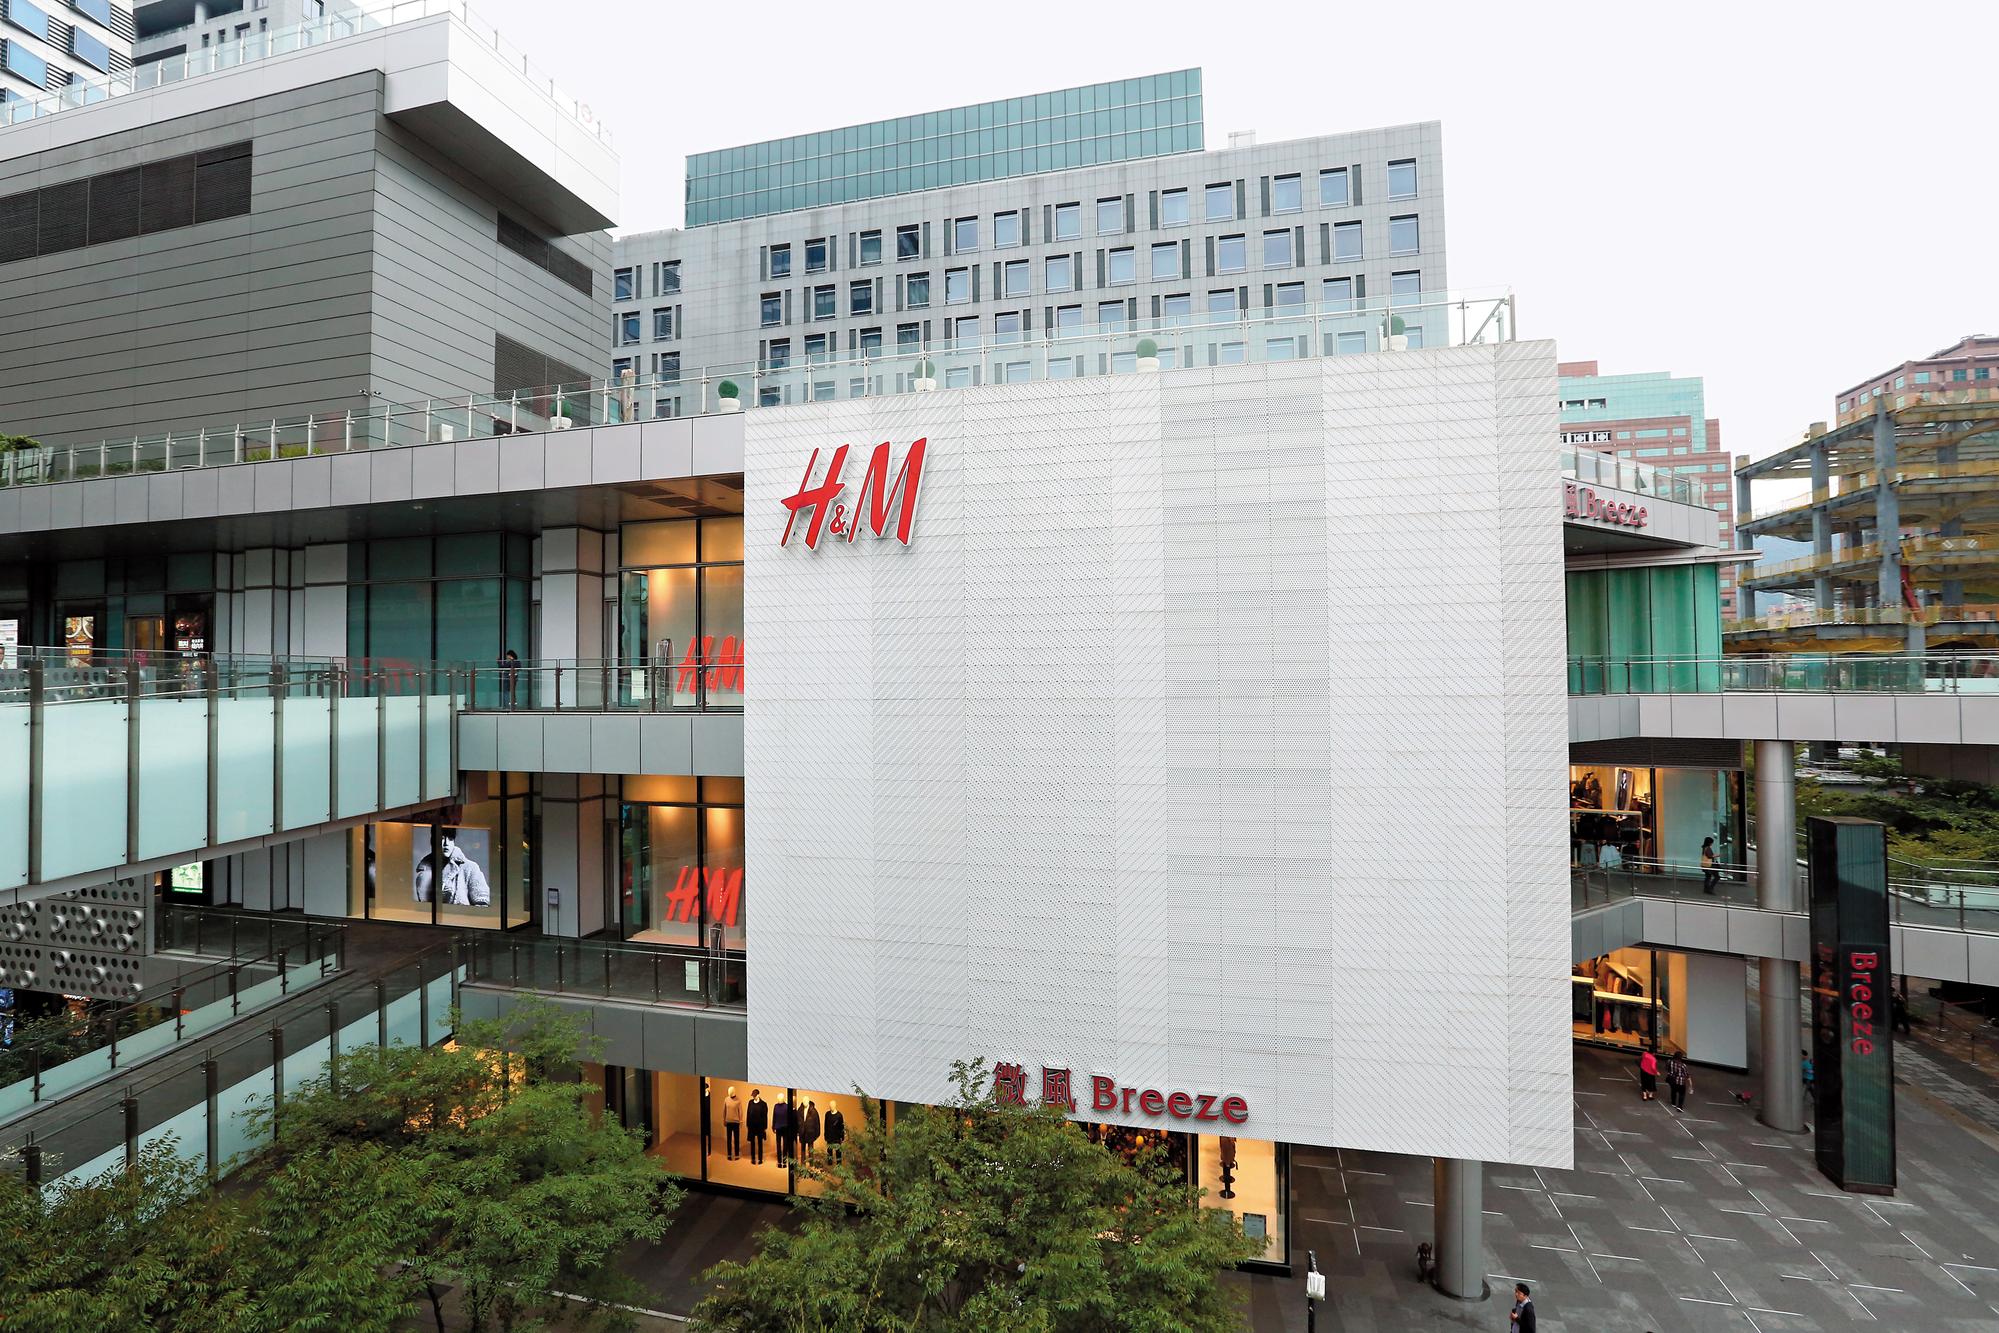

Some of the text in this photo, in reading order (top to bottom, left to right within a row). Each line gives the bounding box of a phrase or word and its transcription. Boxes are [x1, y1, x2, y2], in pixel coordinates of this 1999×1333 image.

[780, 437, 928, 551] H&M
[1582, 488, 1648, 527] Breeze
[1850, 952, 1878, 1056] Breeze
[992, 1060, 1250, 1124] 微風 Breeze
